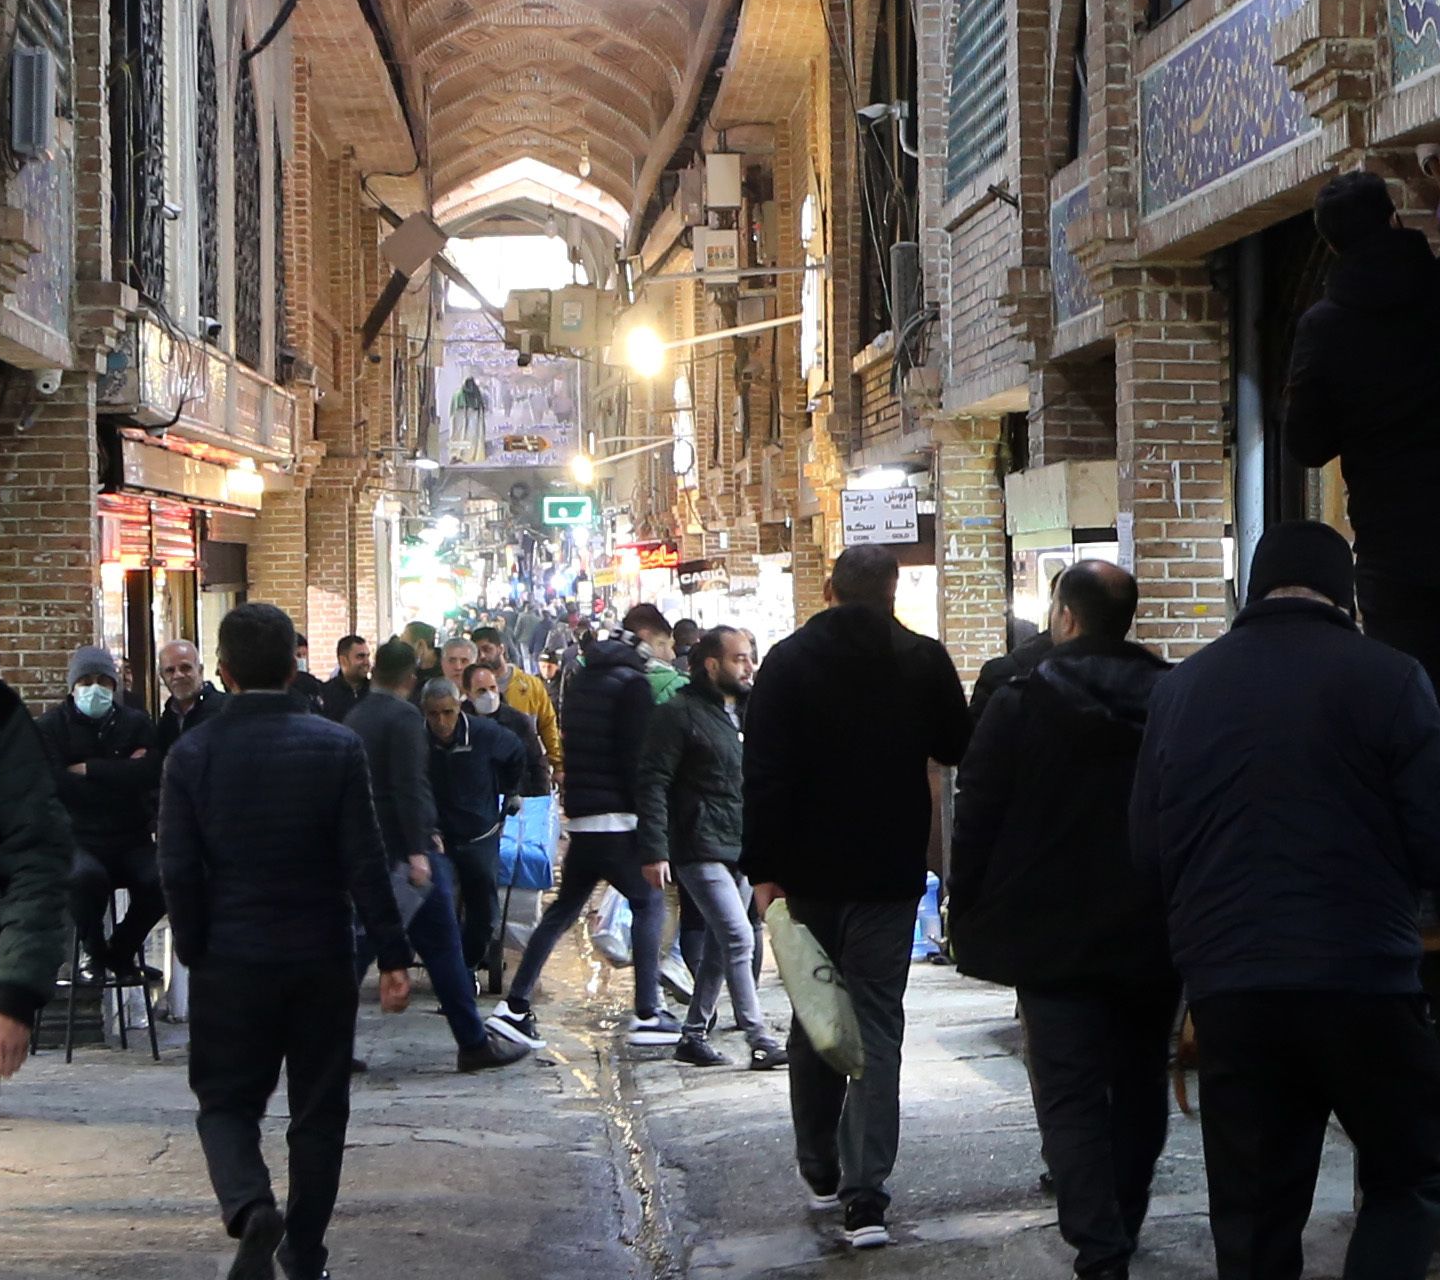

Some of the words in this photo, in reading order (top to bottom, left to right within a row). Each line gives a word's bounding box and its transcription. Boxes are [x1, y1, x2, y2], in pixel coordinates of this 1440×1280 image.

[844, 493, 874, 504] خرید
[883, 490, 913, 504] فروش
[846, 521, 876, 532] سکه
[885, 519, 915, 530] طلا
[680, 568, 725, 585] CASIO
